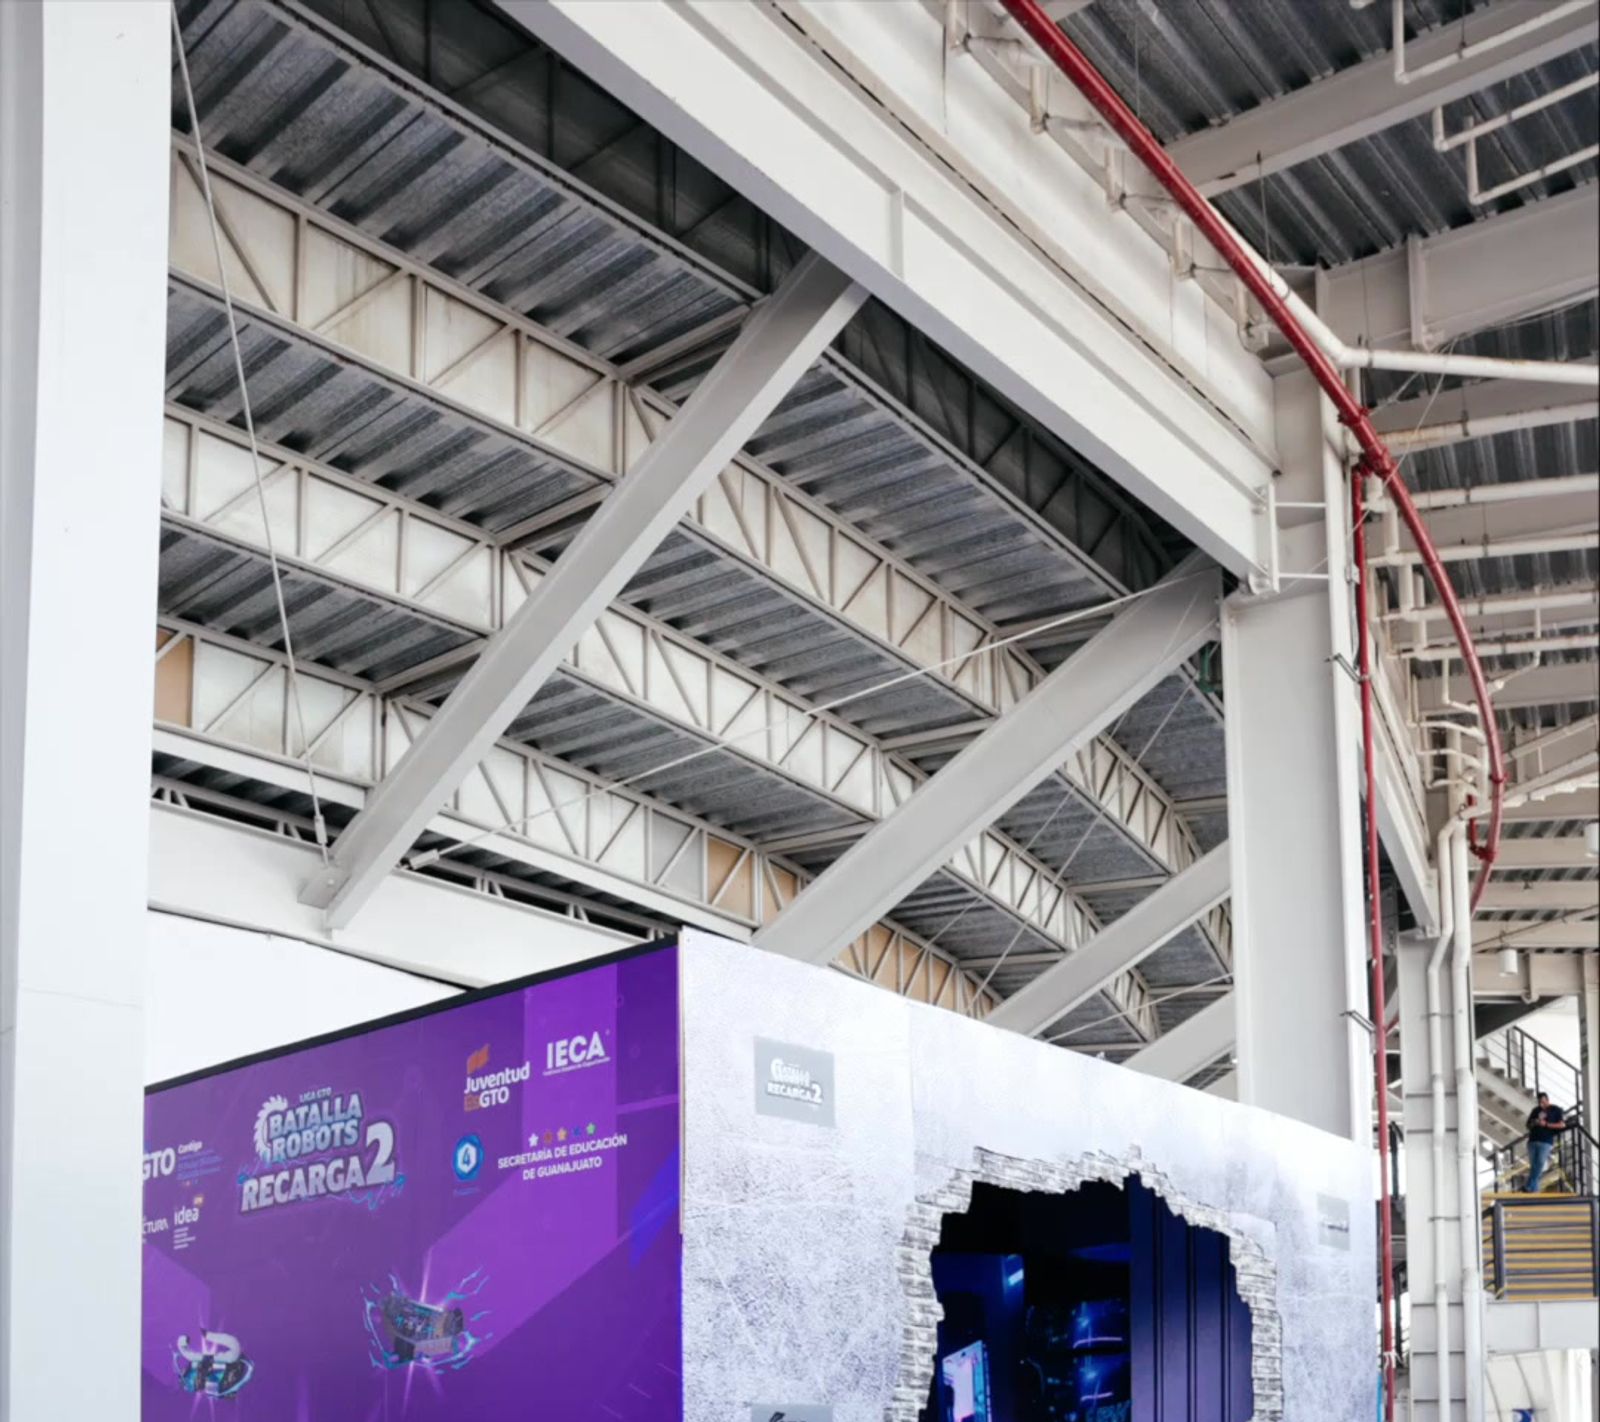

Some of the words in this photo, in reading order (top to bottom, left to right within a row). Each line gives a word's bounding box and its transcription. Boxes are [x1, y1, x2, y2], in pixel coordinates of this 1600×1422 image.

[547, 1031, 605, 1069] IECA
[464, 1061, 530, 1094] Juventud
[479, 1086, 509, 1108] GTO
[269, 1093, 362, 1138] BATALLA
[272, 1119, 358, 1163] ROBOTS
[498, 1147, 553, 1169] SECRETARÍA
[554, 1145, 567, 1158] DE
[569, 1133, 628, 1155] EDUCACIÓN
[241, 1155, 365, 1212] RECARGA
[366, 1121, 395, 1186] 2
[523, 1169, 536, 1180] DE
[537, 1156, 603, 1178] GUANAJUATO
[174, 1205, 199, 1225] idea
